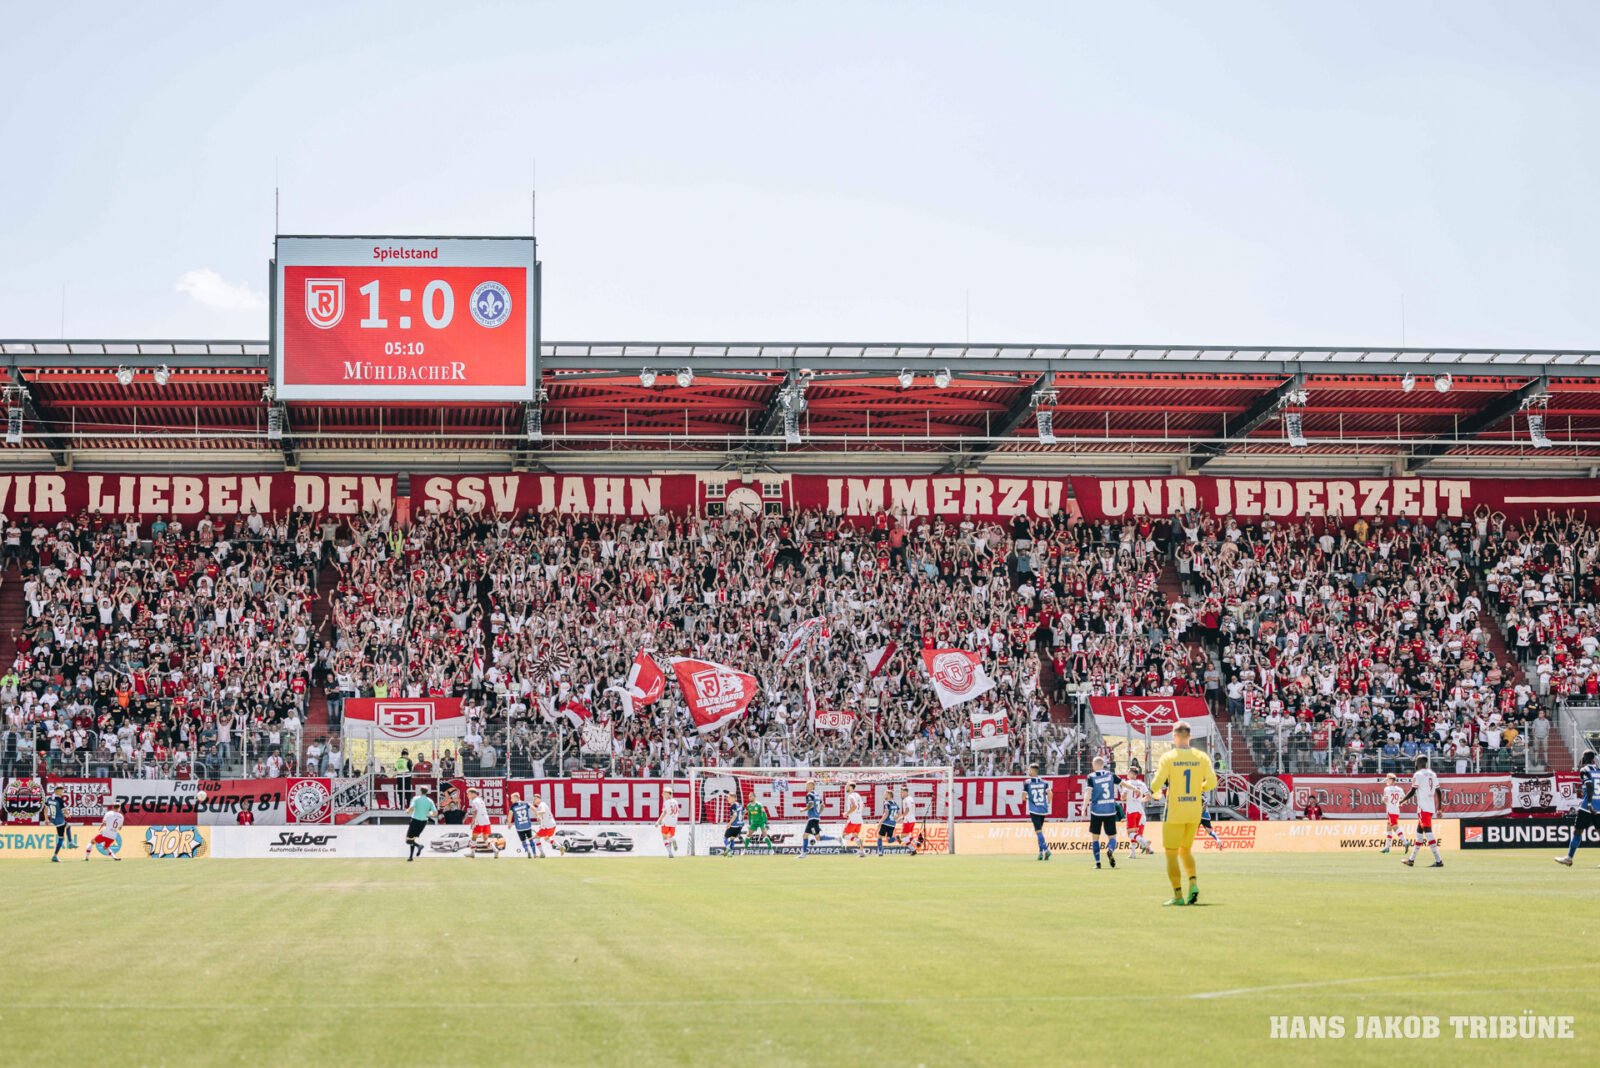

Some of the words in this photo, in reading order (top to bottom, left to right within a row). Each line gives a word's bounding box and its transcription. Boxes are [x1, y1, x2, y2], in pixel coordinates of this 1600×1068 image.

[373, 247, 438, 262] Spielstand
[359, 279, 455, 329] 1:0
[384, 342, 424, 355] 05:10
[344, 361, 466, 380] MÜHLBACHER
[88, 475, 272, 514] LIEBEN
[293, 475, 394, 514] DEN
[424, 476, 520, 514] SSV
[538, 476, 662, 516] JAHN
[826, 478, 1064, 518] IMMERZU
[1099, 479, 1198, 516] UND
[1214, 479, 1471, 518] JEDERZEIT
[174, 781, 221, 792] Fanclub
[1183, 769, 1190, 794] 1
[1032, 789, 1044, 802] 23
[1102, 783, 1110, 799] 3
[1314, 788, 1343, 806] Die
[1441, 788, 1487, 806] Tower
[1391, 792, 1399, 804] 29
[258, 792, 281, 811] 81
[1289, 824, 1312, 836] MIT
[1315, 824, 1340, 836] UNS
[154, 830, 194, 856] TOR
[270, 832, 337, 845] Sieber
